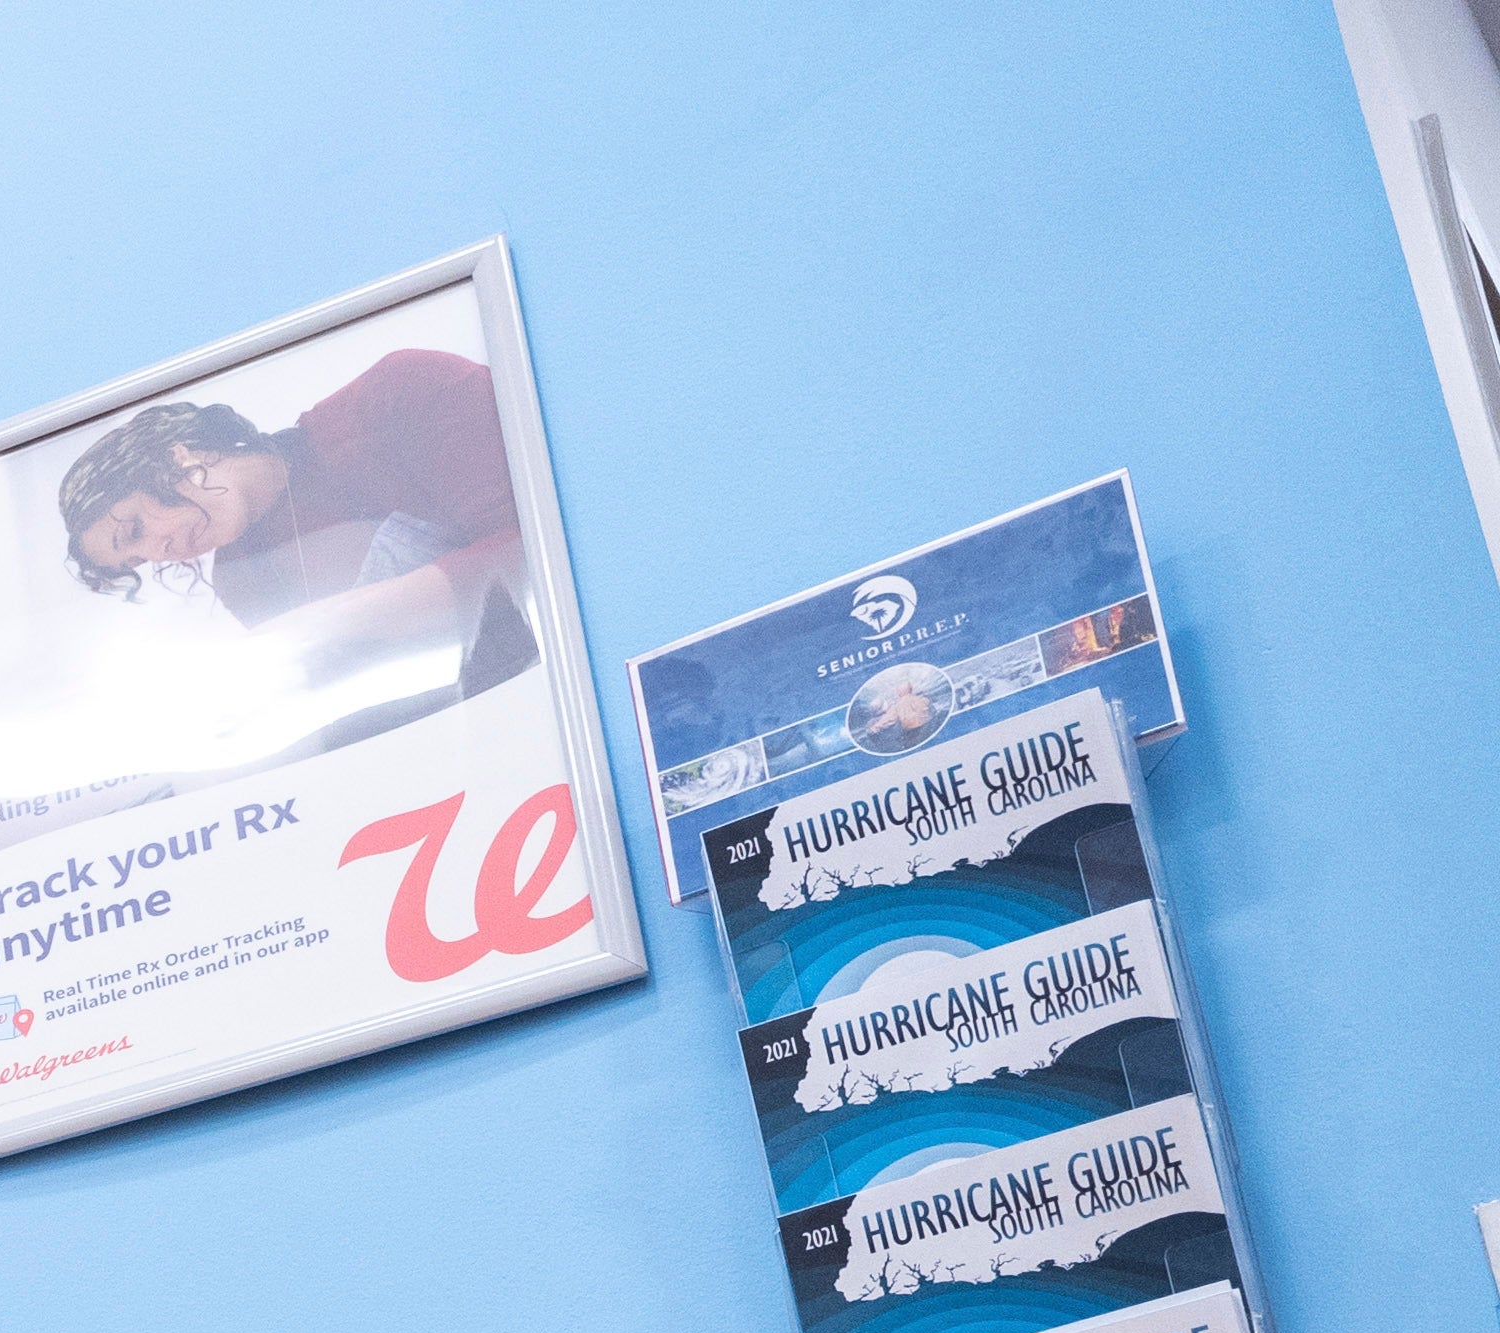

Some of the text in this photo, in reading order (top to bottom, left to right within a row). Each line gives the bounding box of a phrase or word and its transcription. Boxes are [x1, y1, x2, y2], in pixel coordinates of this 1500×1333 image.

[816, 641, 894, 678] SENIOR
[899, 612, 970, 647] P.R.E.P.
[783, 720, 1091, 864] HURRICANE GUIDE
[904, 759, 1098, 847] SOUTH CAROLINA
[106, 820, 221, 889] your
[233, 798, 301, 841] Rx
[726, 836, 762, 865] 2021
[42, 916, 305, 1004] Real Time Rx Order Tracking
[45, 928, 330, 1022] available online and in our app
[821, 933, 1135, 1066] HURRICANE GUIDE
[763, 1036, 799, 1064] 2021
[946, 969, 1142, 1053] SOUTH CAROLINA
[861, 1127, 1182, 1254] HURRICANE GUIDE
[989, 1162, 1190, 1245] SOUTH CAROLINA
[802, 1225, 839, 1252] 2021
